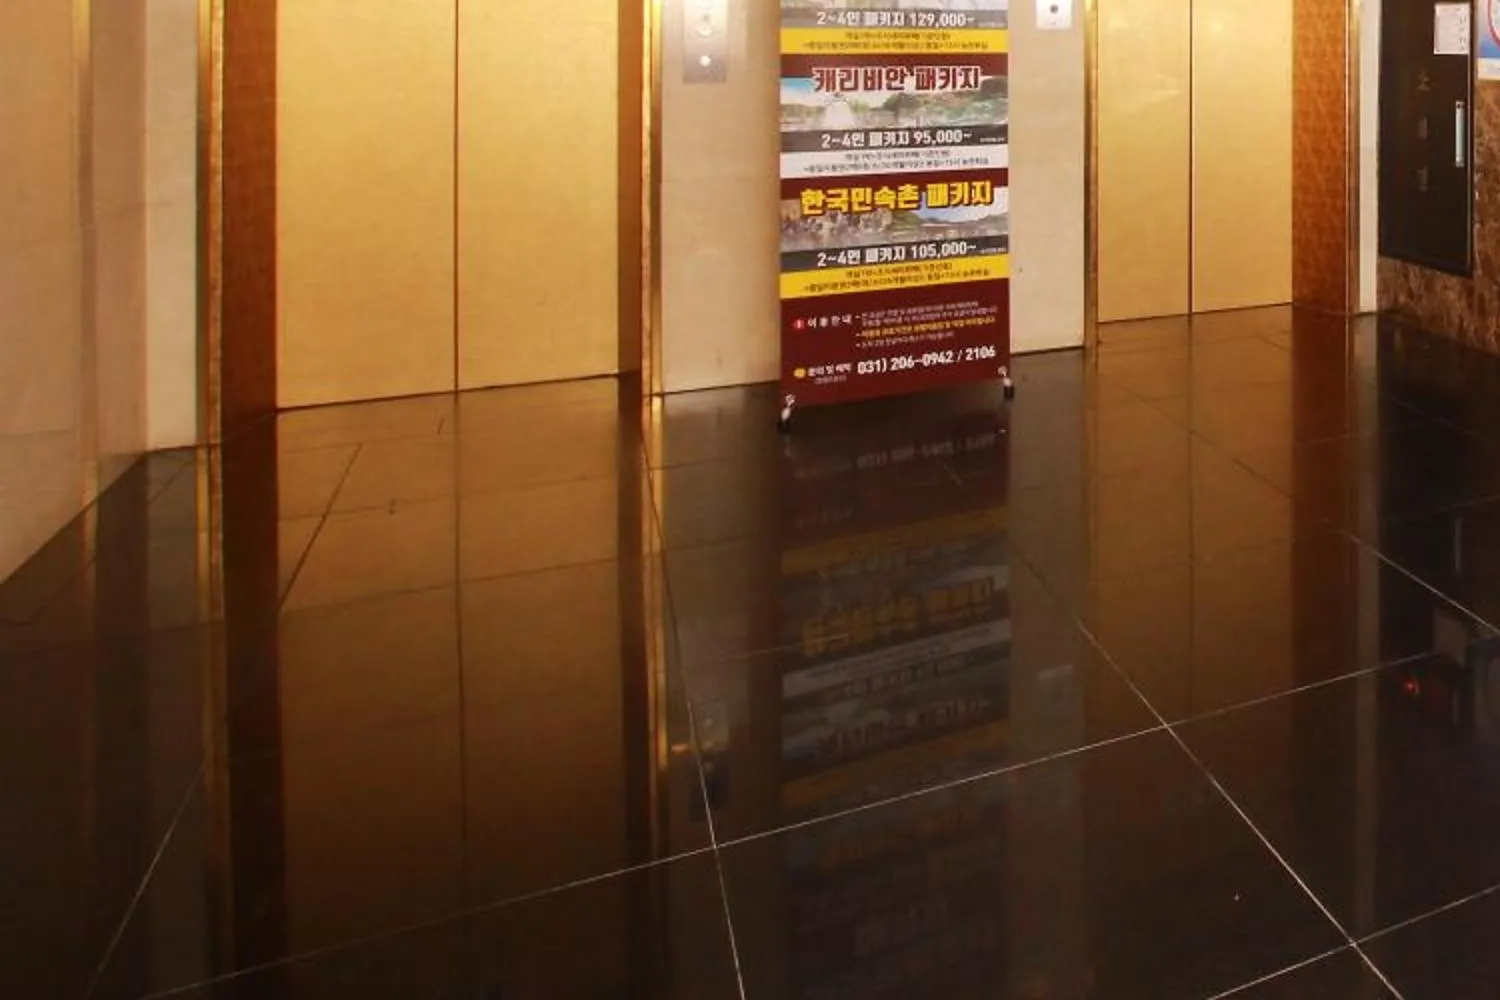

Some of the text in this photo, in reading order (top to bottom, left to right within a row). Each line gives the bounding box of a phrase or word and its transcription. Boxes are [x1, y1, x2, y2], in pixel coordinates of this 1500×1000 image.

[864, 11, 905, 27] 패키지
[812, 66, 982, 93] 캐리비안 패키지
[868, 131, 909, 147] 패키지
[801, 180, 993, 217] 한국민속촌 패키지
[865, 246, 906, 264] 패키지
